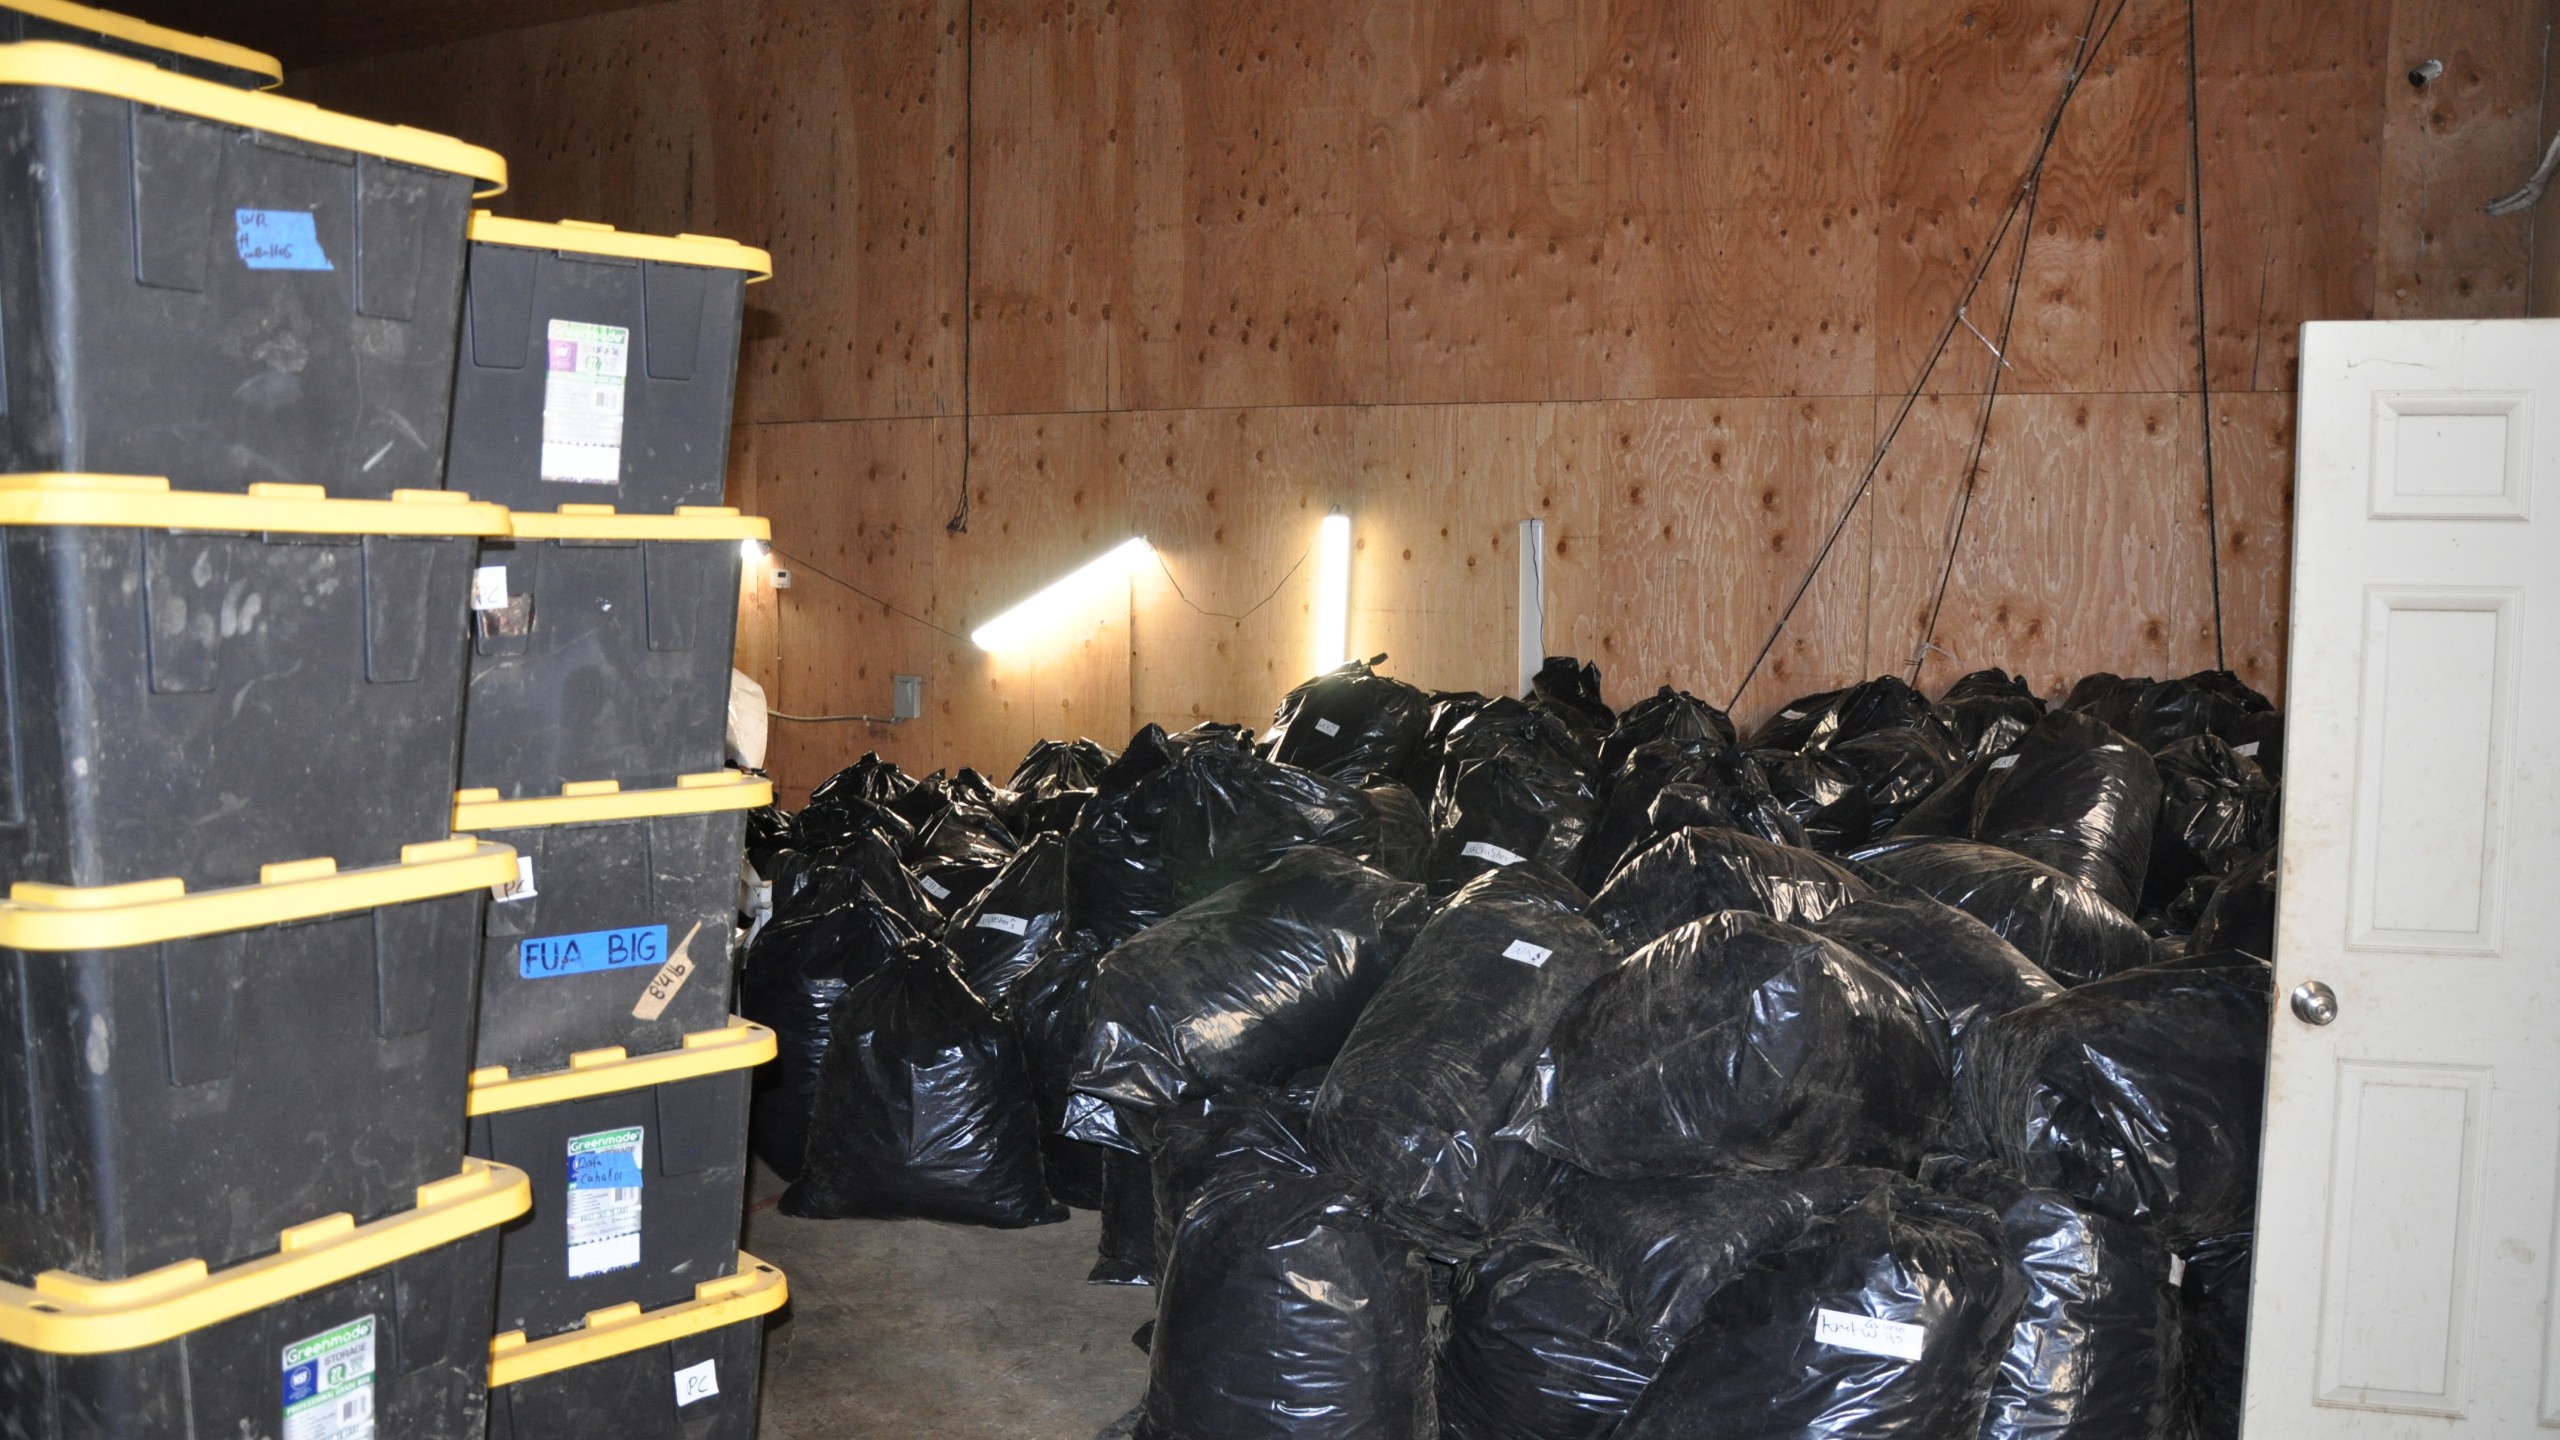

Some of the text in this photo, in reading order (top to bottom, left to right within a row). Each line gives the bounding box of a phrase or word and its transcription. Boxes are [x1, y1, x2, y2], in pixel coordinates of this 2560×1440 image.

[525, 931, 656, 974] FUA BIG
[571, 1131, 637, 1152] Greenmade
[287, 1323, 369, 1362] Greenmade
[324, 1342, 367, 1365] STORAGE
[687, 1375, 708, 1396] PC
